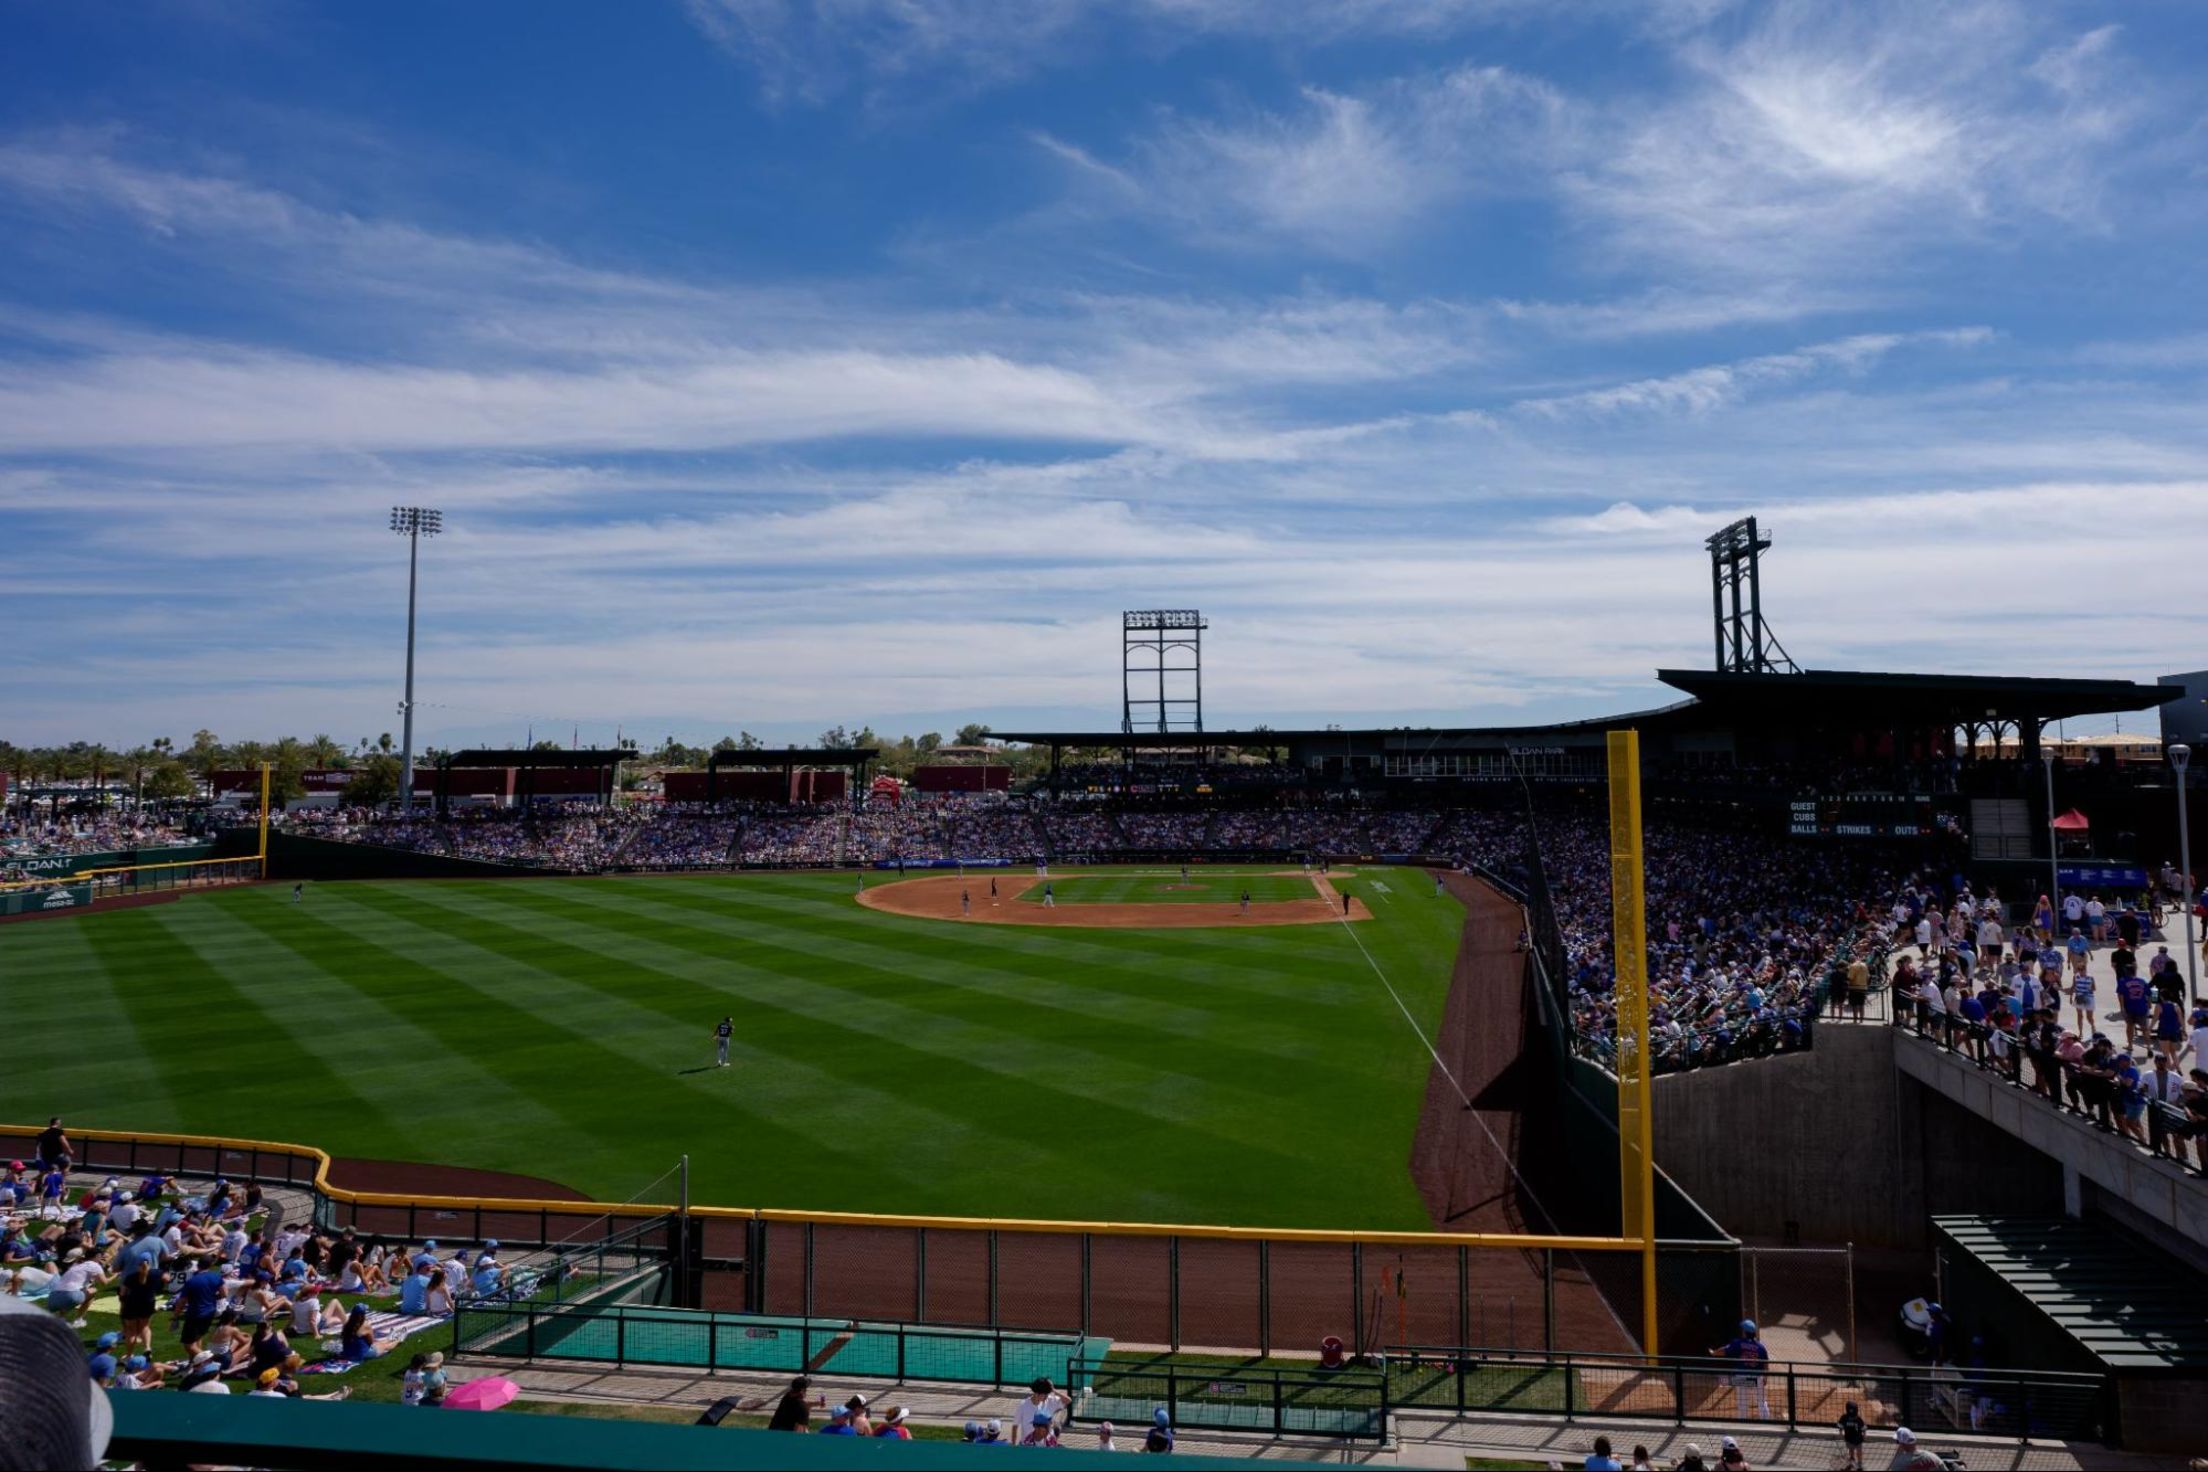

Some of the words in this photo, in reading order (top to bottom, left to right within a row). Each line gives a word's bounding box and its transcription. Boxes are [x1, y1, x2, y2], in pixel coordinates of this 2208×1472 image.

[1790, 802, 1816, 811] GUEST
[1793, 812, 1816, 822] CUBS
[1791, 824, 1817, 834] BALLS
[1836, 825, 1872, 835] STRIKES
[1895, 825, 1919, 836] OUTS
